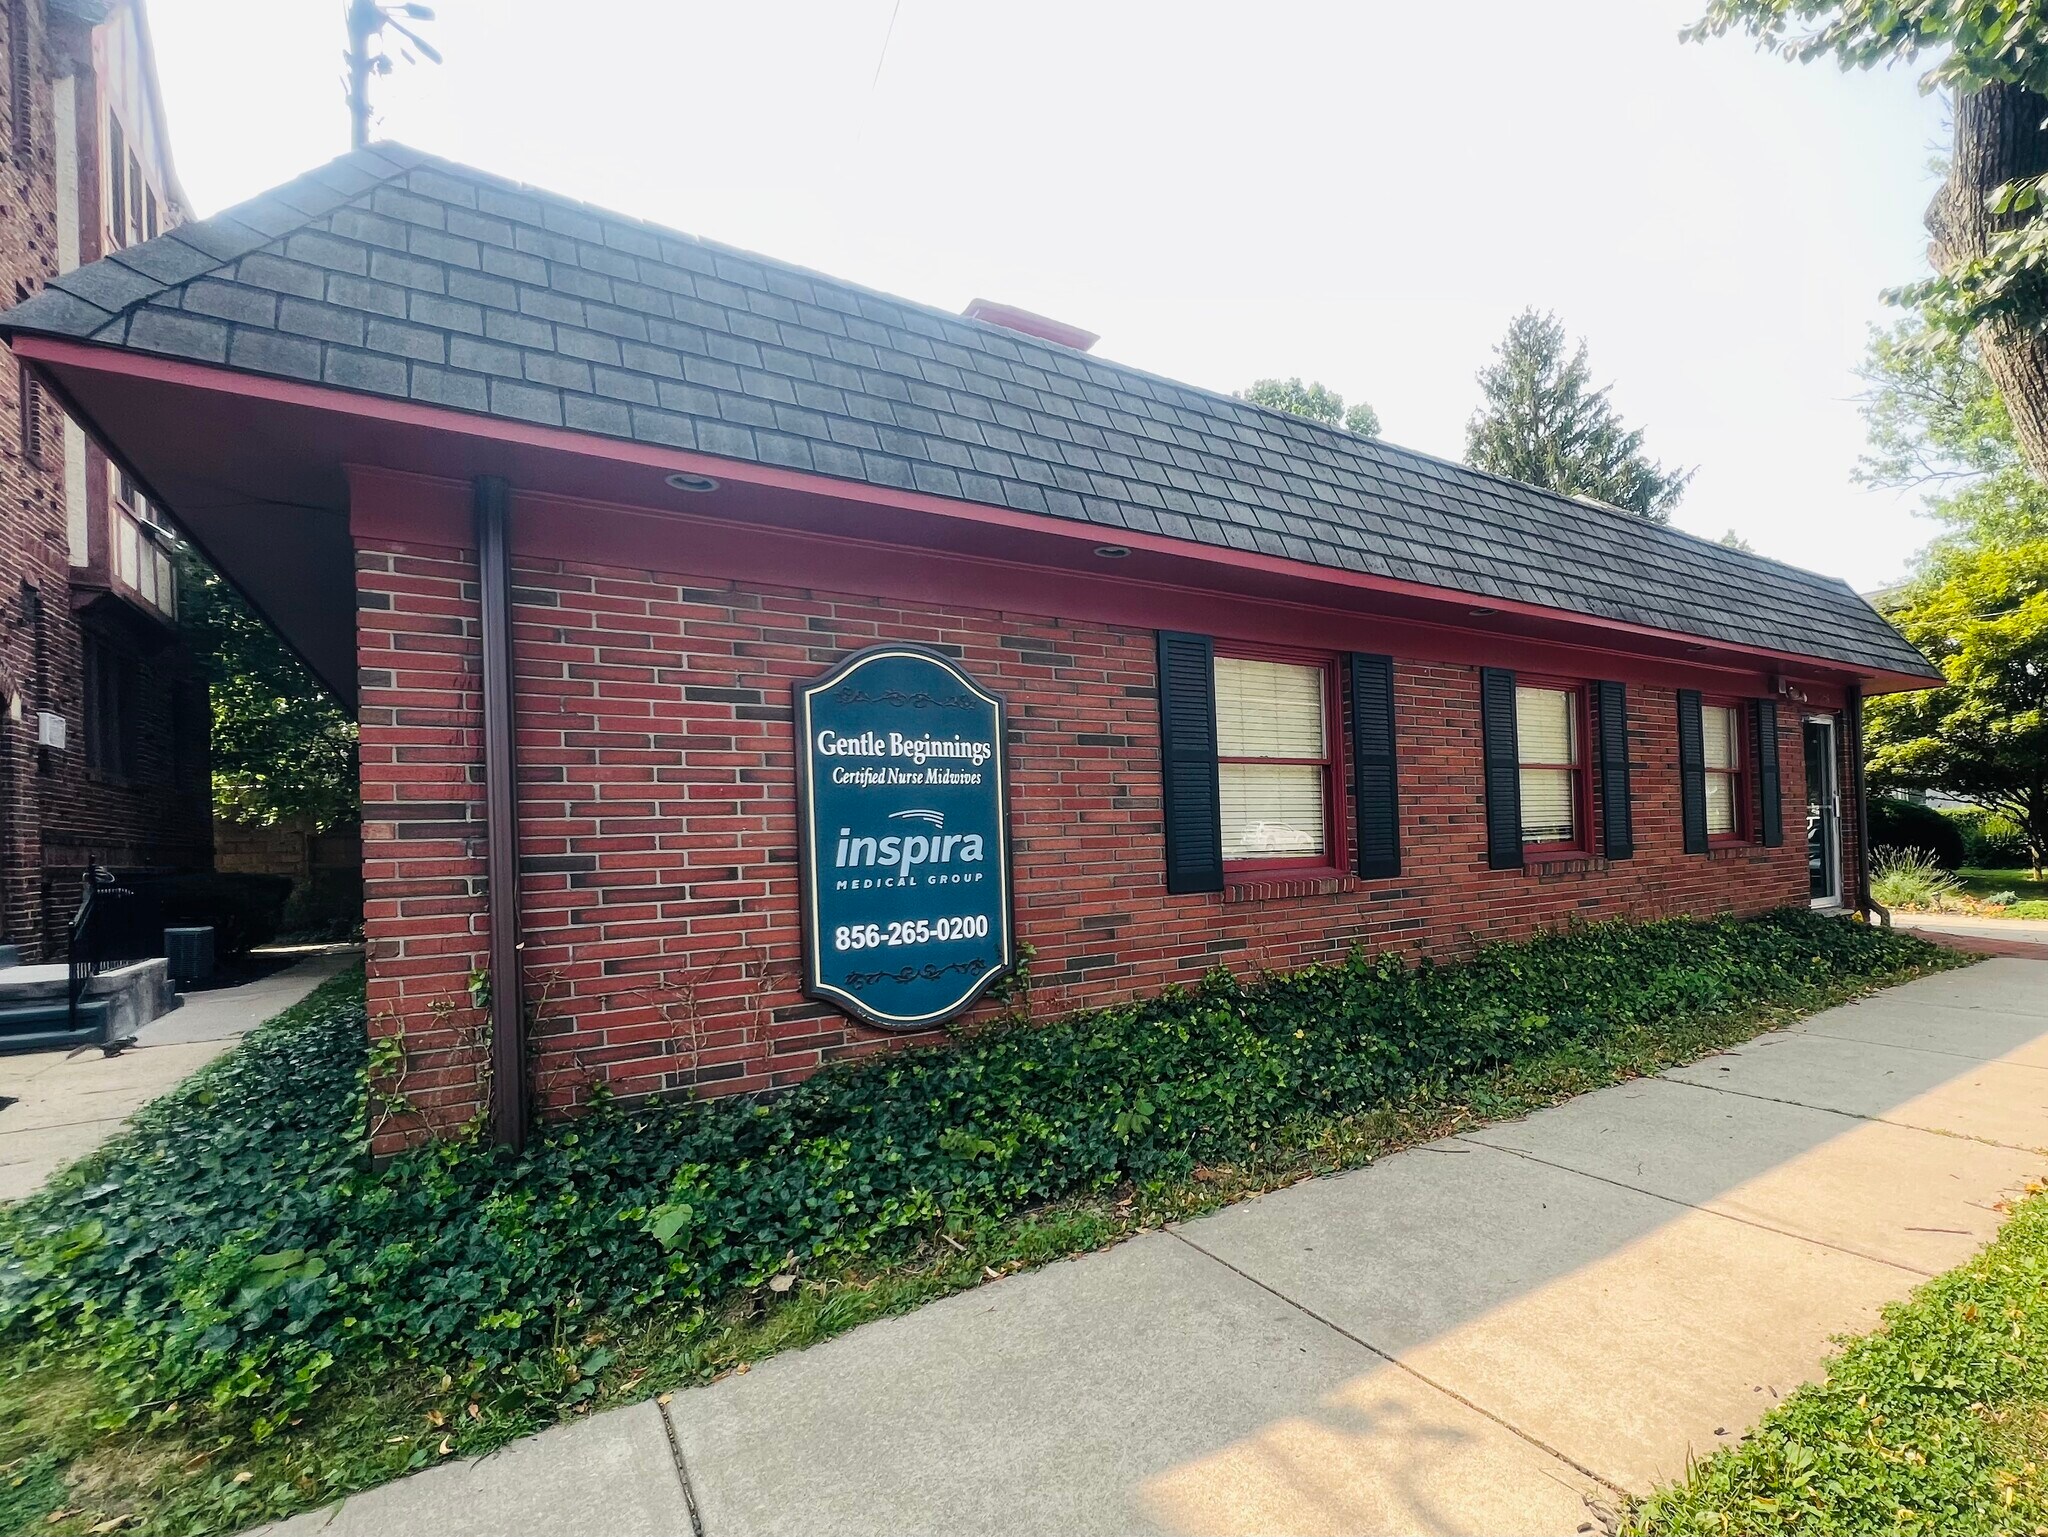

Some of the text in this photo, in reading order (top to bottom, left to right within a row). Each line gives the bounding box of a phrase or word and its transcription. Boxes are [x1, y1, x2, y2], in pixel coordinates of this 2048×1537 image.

[817, 730, 991, 765] Gentle Beginnings
[832, 766, 982, 787] Certified Nurse Midwives
[835, 827, 984, 877] inspira
[836, 873, 984, 890] MEDICAL GROUP
[835, 915, 989, 951] 856-265-0200
